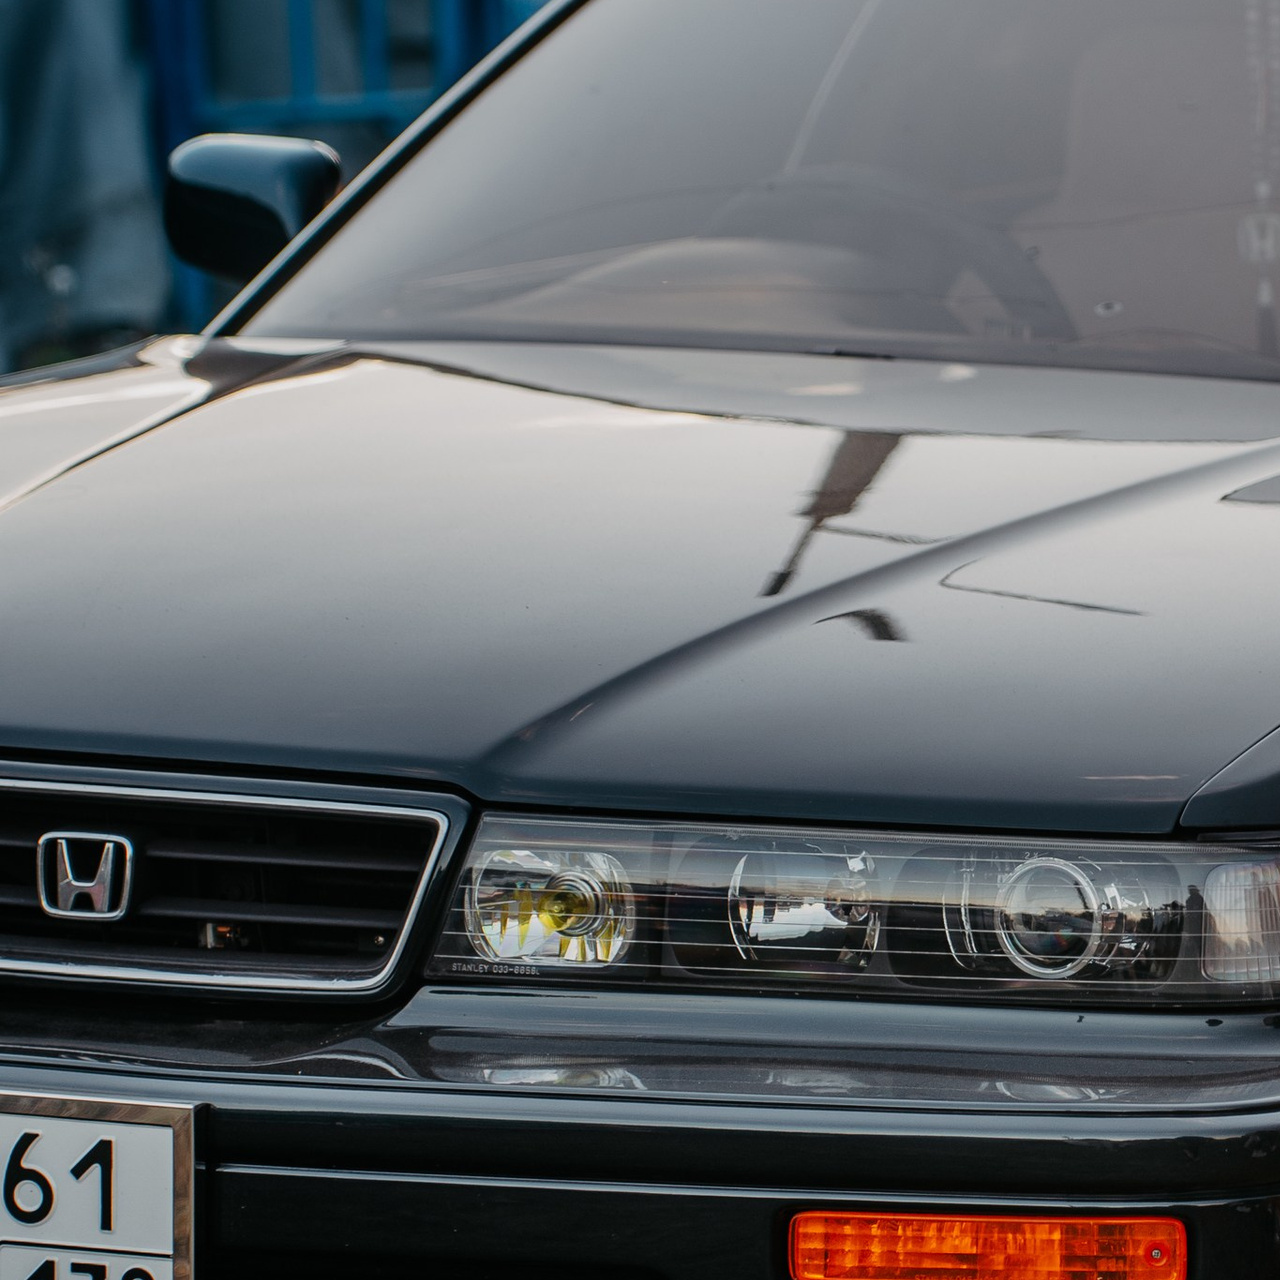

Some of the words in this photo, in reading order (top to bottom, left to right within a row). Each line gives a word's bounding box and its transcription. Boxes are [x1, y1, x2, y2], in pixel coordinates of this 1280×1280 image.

[57, 839, 114, 912] H
[452, 962, 490, 973] STANLEY
[3, 1131, 113, 1232] 61
